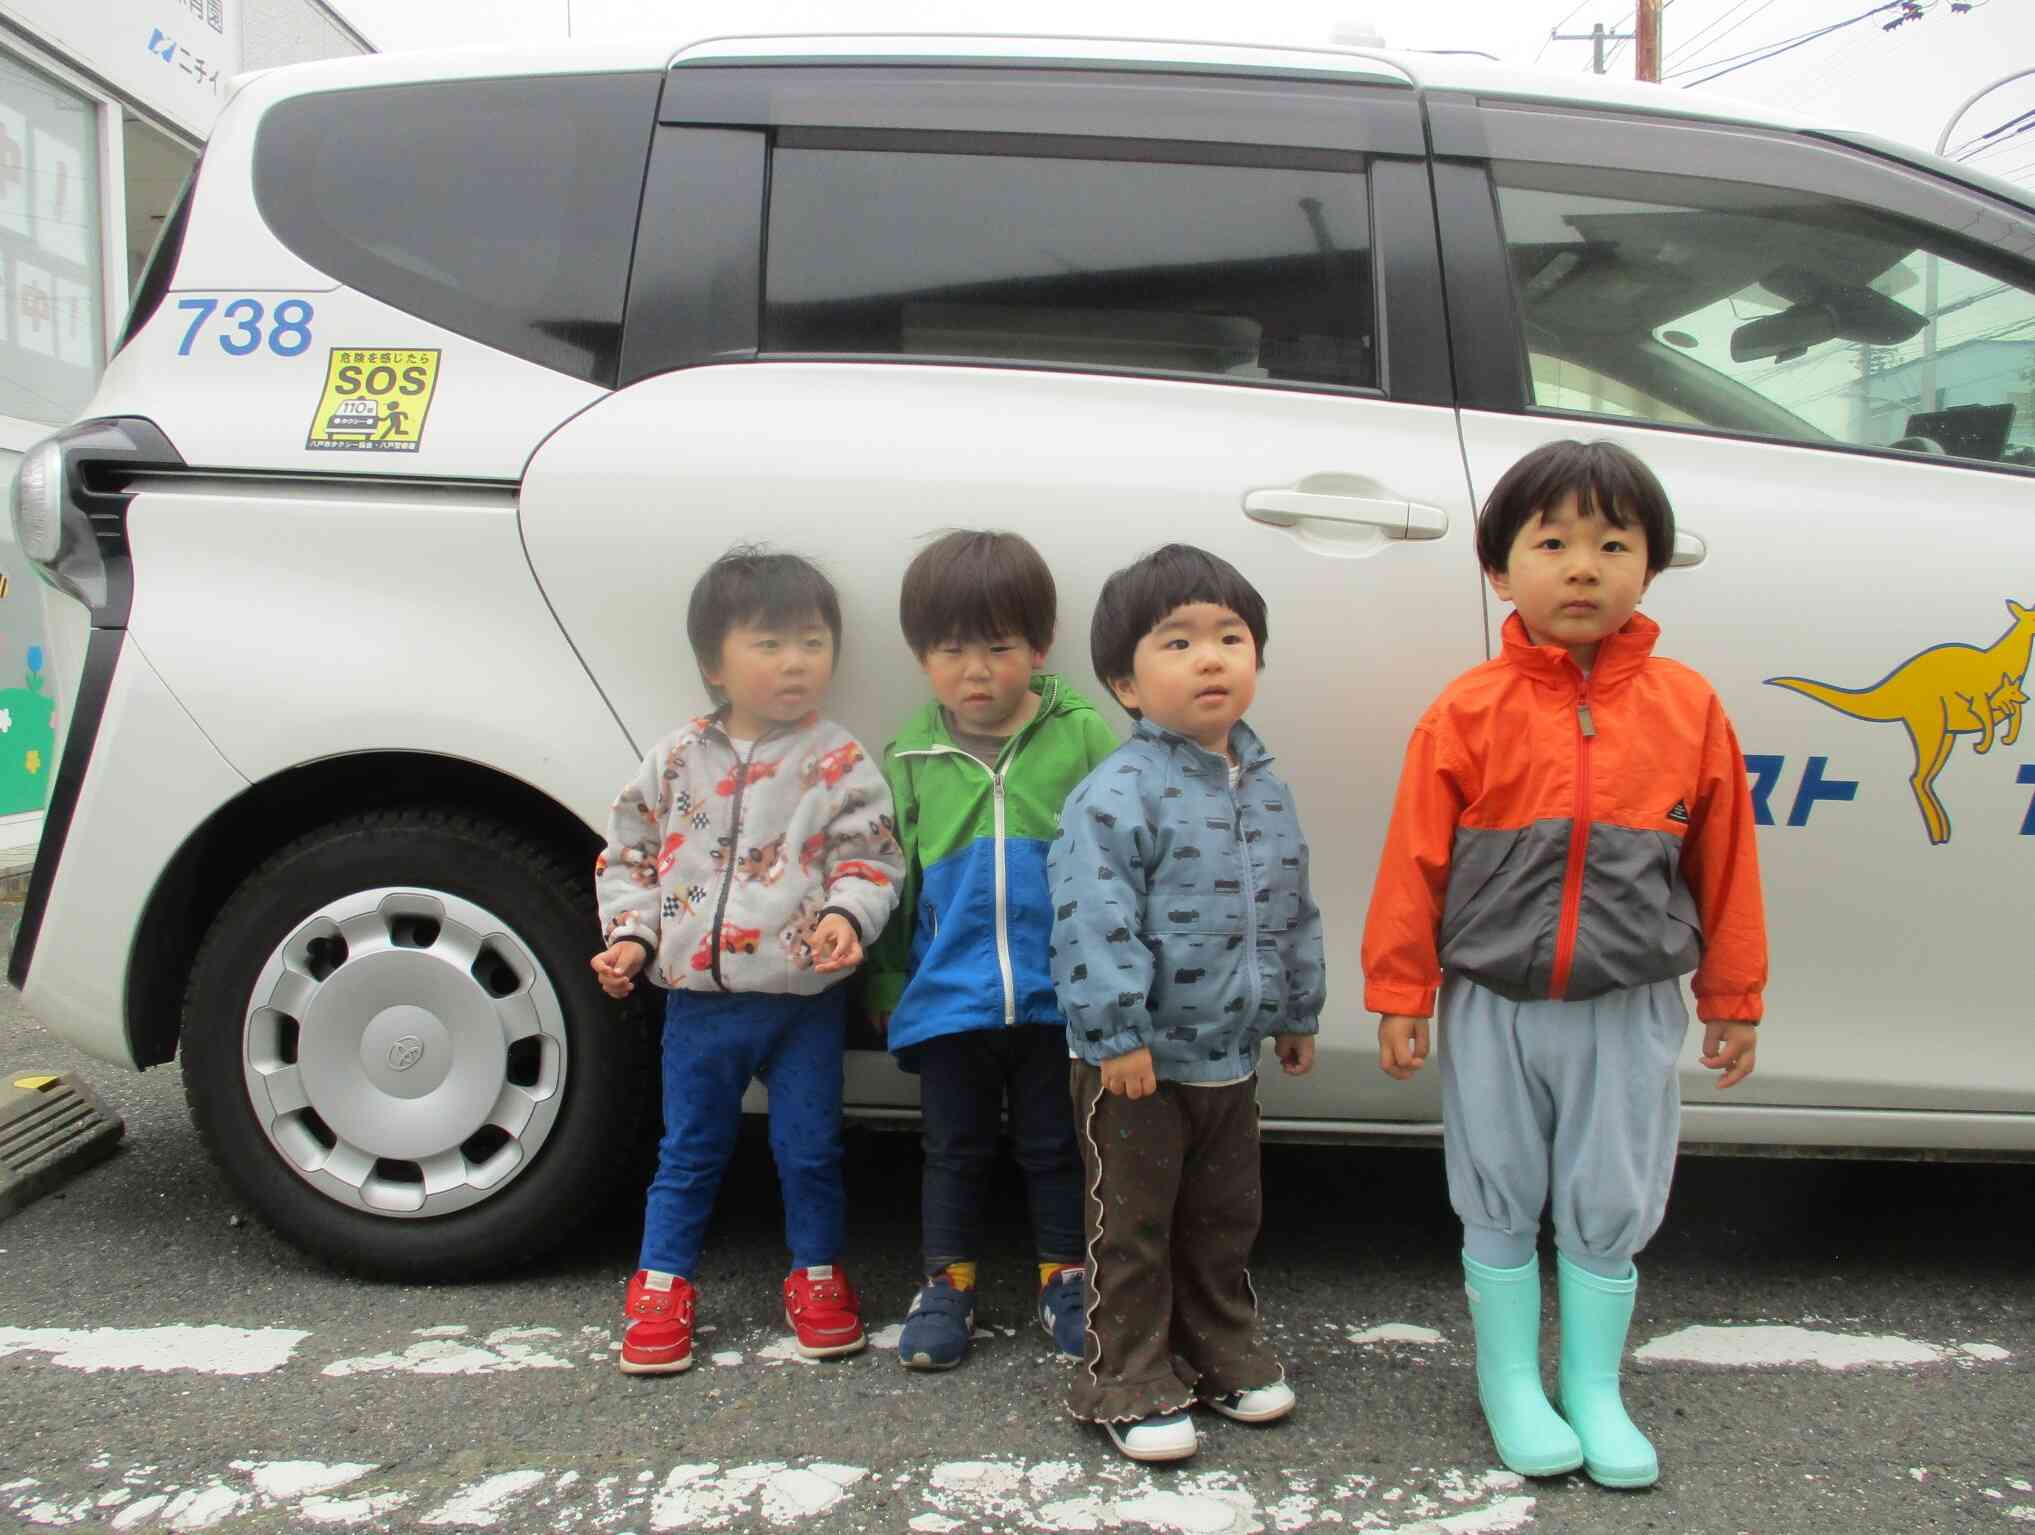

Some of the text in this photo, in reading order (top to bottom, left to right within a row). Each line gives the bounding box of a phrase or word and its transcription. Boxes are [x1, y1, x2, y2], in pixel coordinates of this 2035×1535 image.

[179, 47, 219, 96] ニチイ
[177, 299, 314, 357] 738
[340, 352, 429, 364] 危険を感じたら
[335, 366, 427, 395] SOS
